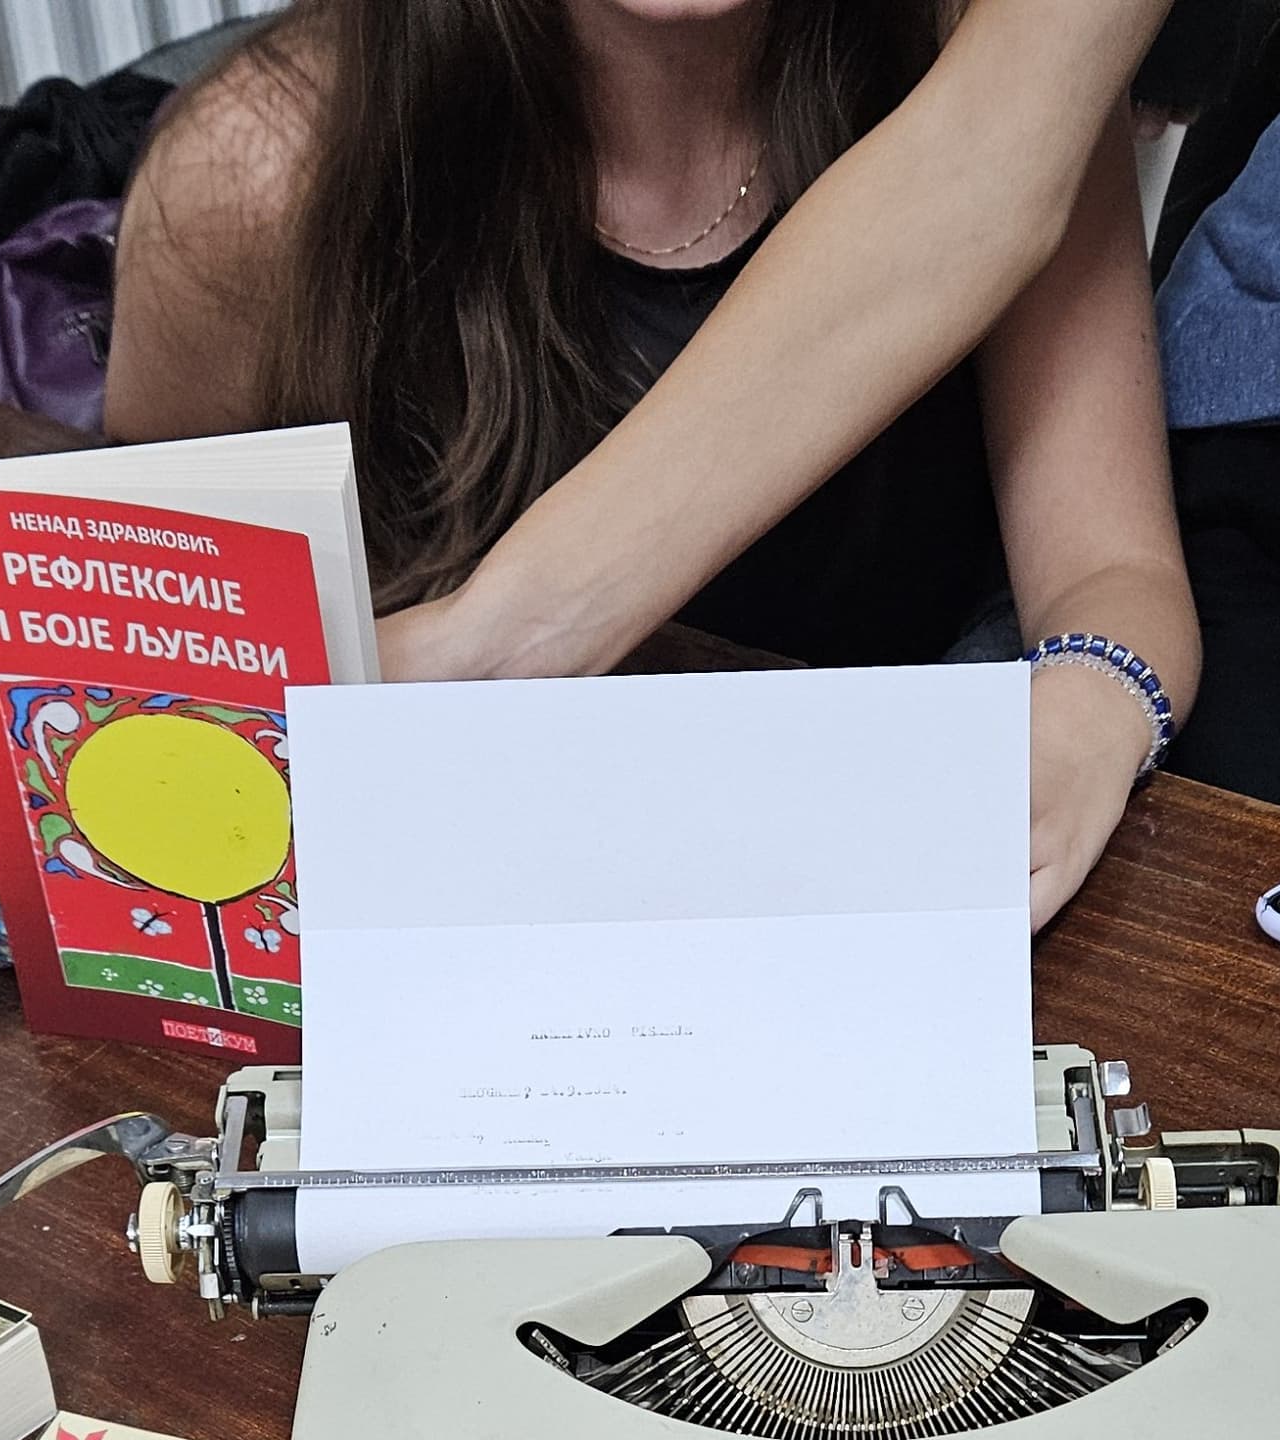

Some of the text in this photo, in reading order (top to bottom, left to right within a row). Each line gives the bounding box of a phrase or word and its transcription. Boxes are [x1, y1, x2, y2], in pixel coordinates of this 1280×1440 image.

[10, 511, 220, 557] НЕНАД ЗДРАВКОВИЋ
[2, 551, 246, 617] РЕФЛЕКСИЈЕ
[20, 612, 112, 654] БОЈЕ
[123, 623, 289, 680] ЉУБАВИ
[163, 1020, 257, 1053] ПОЕТИКУМ
